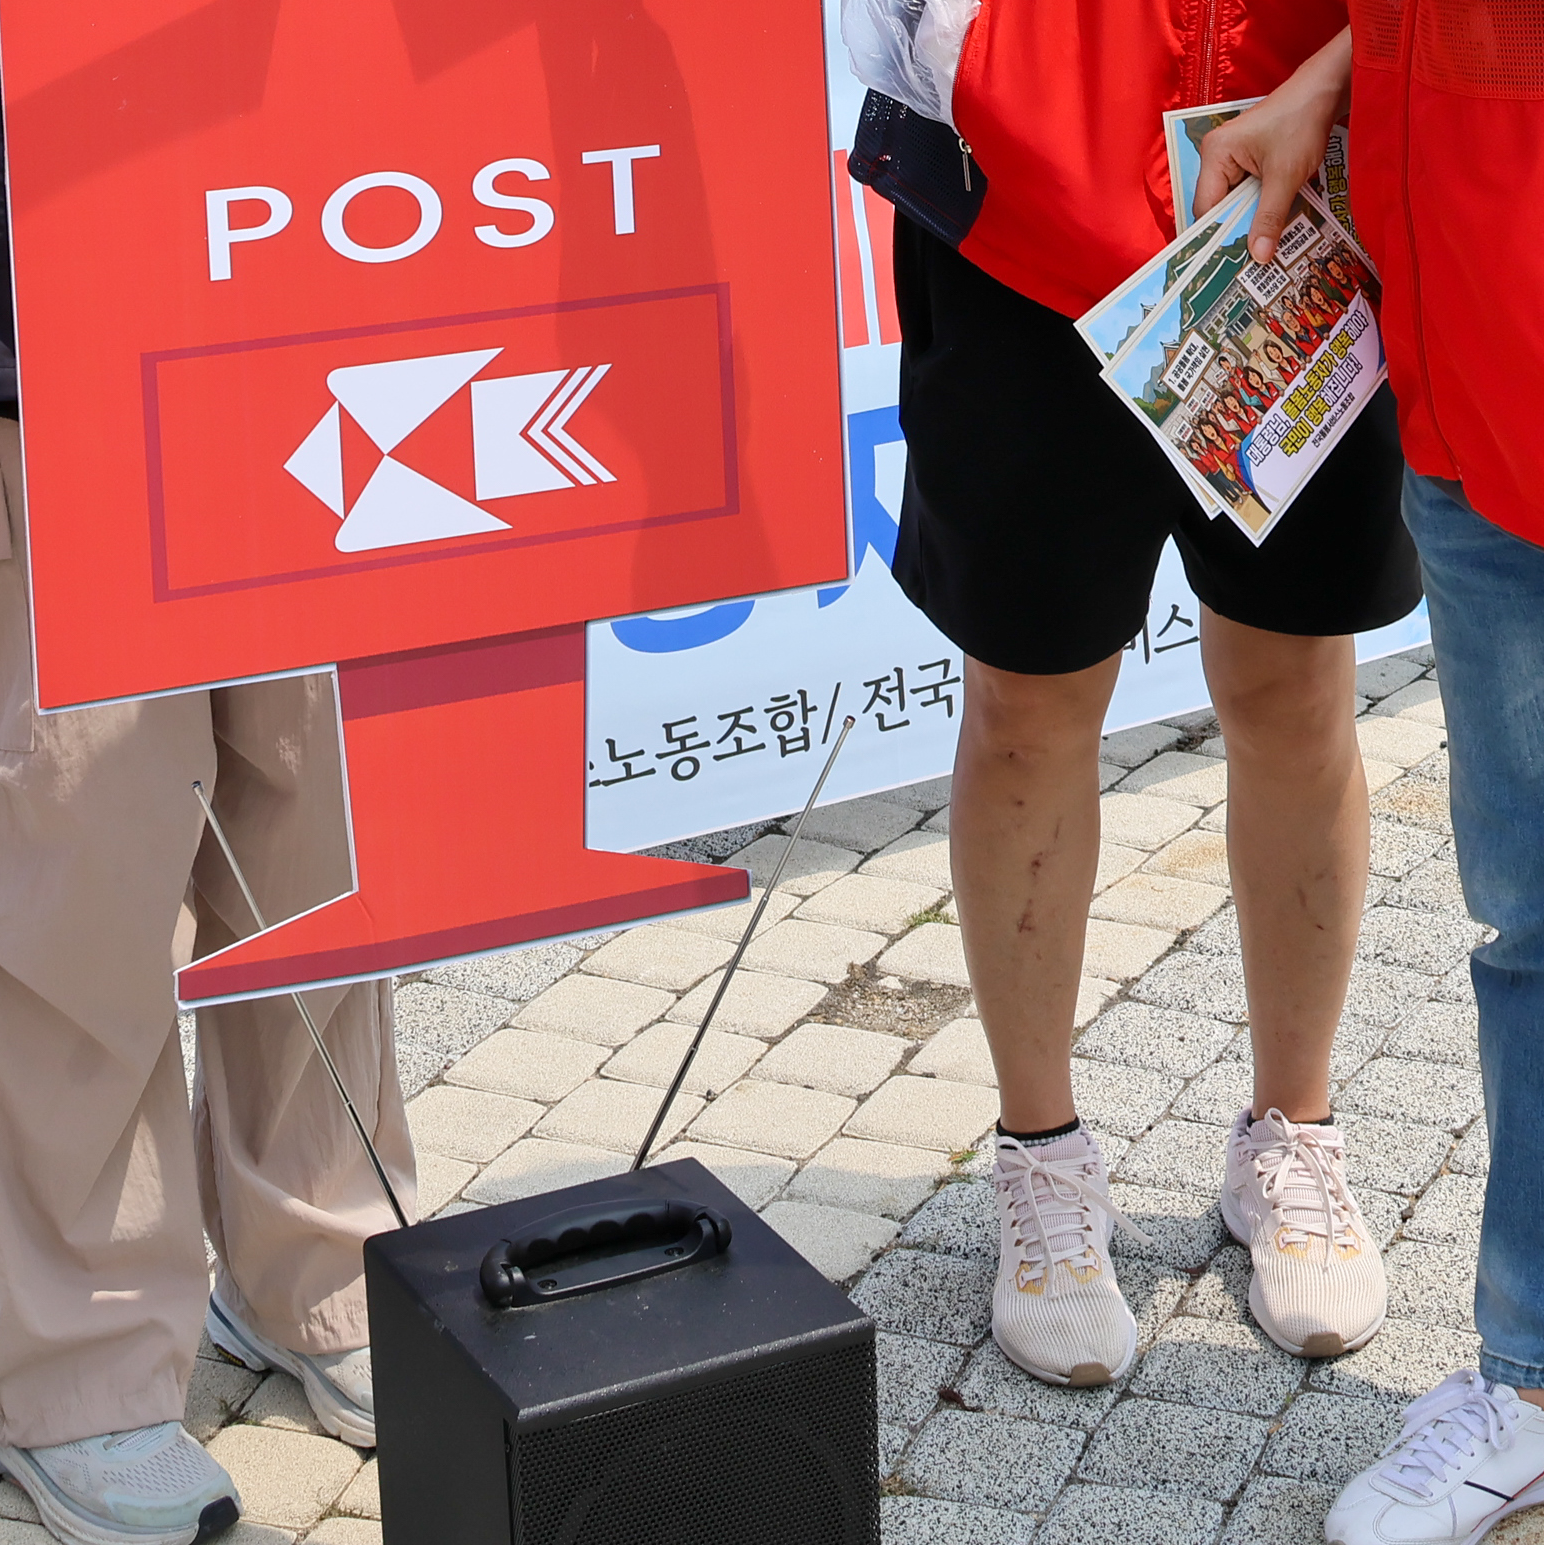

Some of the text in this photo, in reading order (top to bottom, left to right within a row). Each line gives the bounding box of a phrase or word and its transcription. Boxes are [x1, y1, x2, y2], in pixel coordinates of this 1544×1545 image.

[205, 144, 661, 281] POST
[1245, 414, 1291, 467] 대통령님,
[1281, 353, 1337, 424] 돌봄노동자가
[1328, 309, 1370, 361] 행복해야
[1279, 354, 1363, 457] 국민이 행복해집니다!
[589, 657, 963, 789] 노동조합/ 전국
